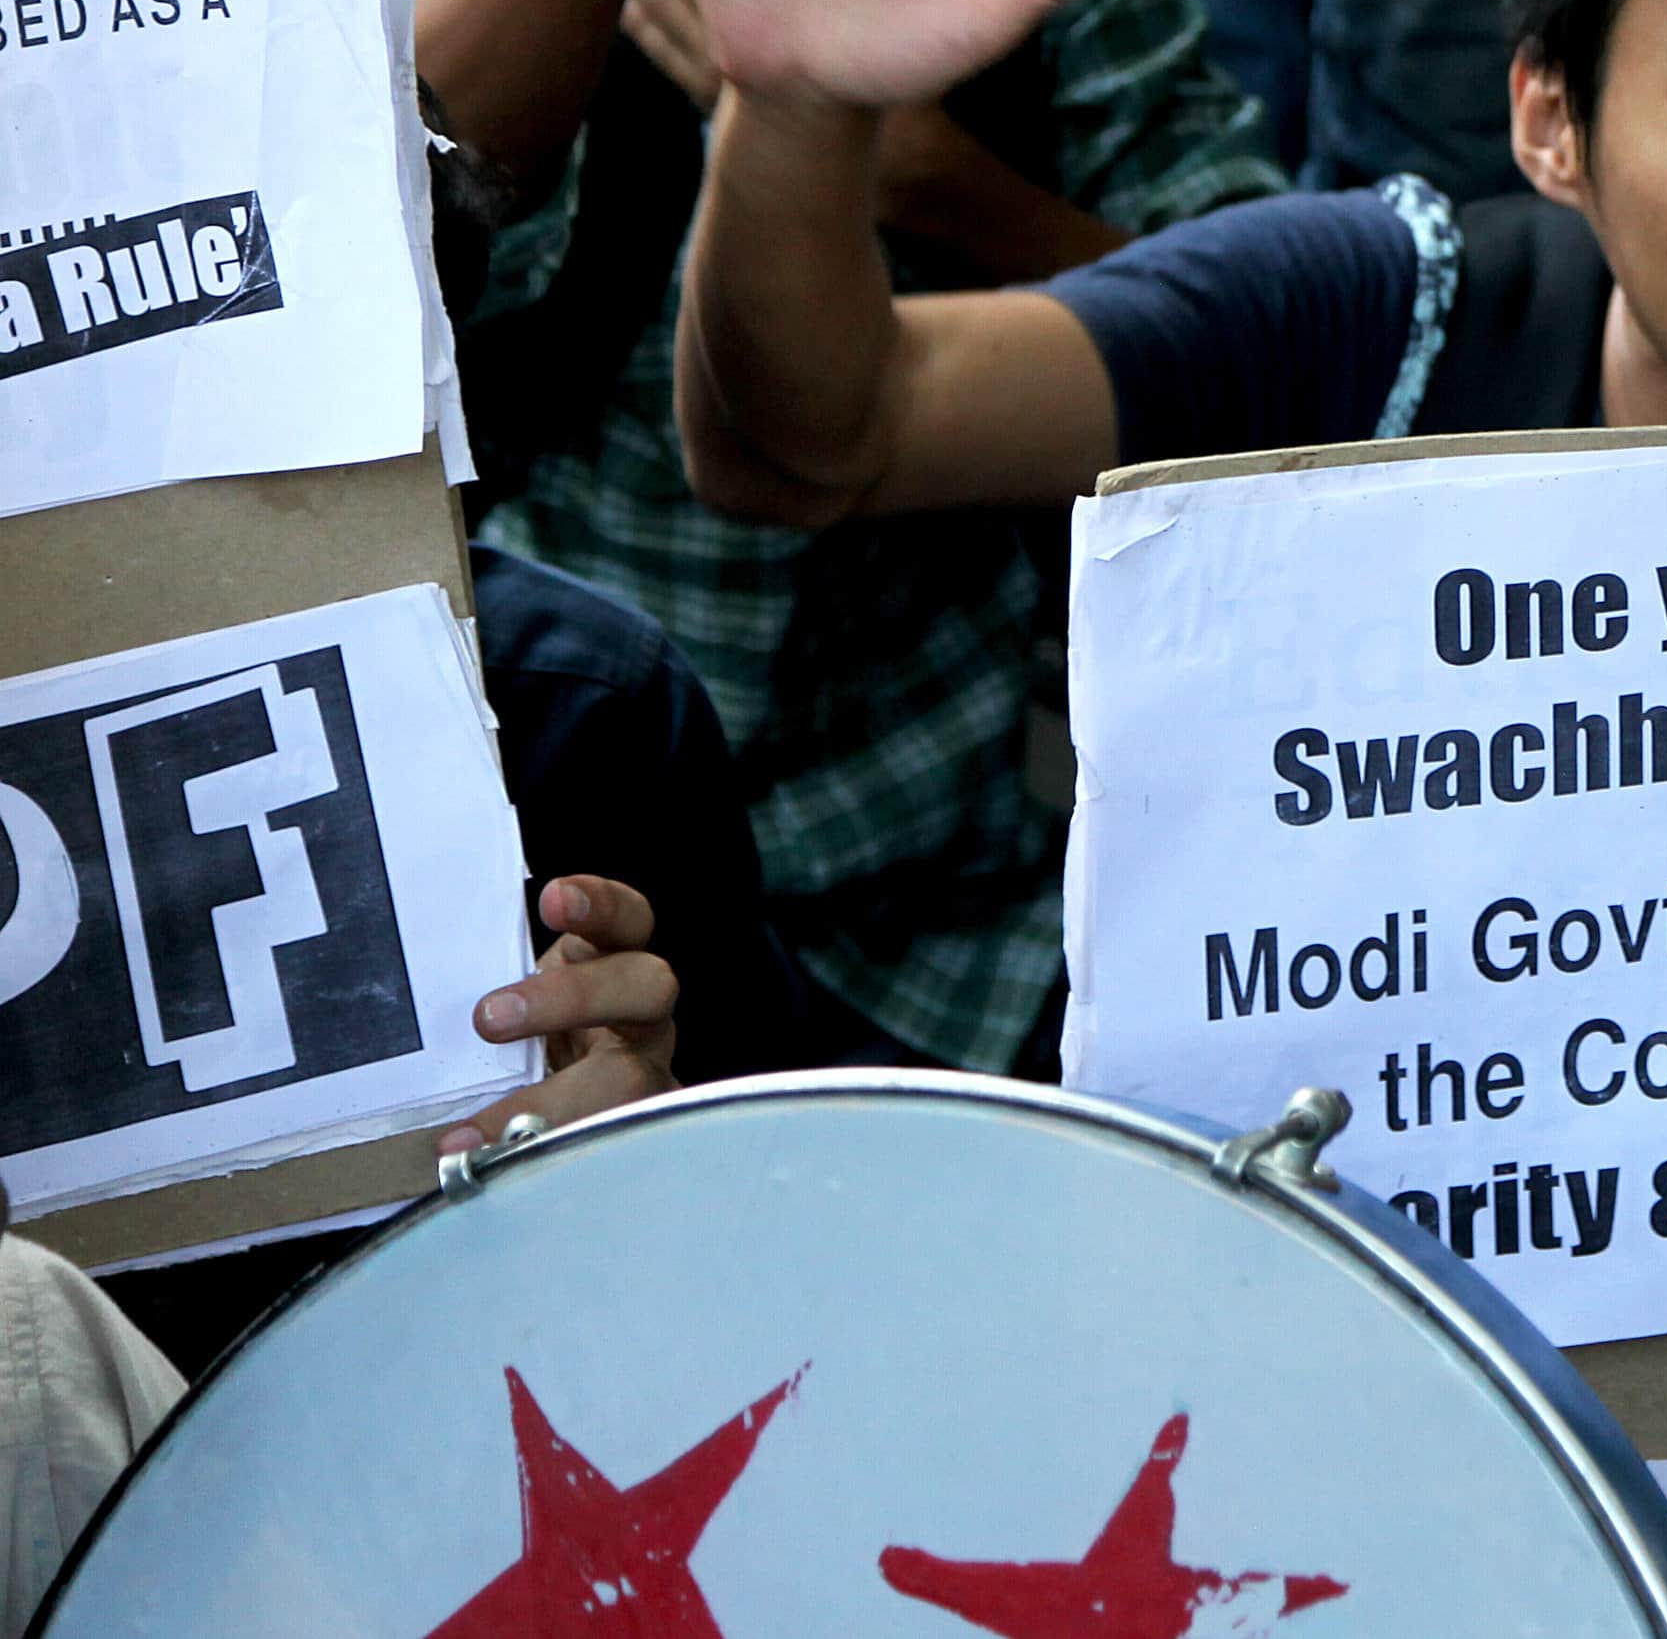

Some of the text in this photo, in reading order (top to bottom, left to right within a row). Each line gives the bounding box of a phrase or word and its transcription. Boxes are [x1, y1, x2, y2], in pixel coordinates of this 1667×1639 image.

[1435, 566, 1629, 666] One
[1205, 909, 1430, 1021] Modi
[1379, 1043, 1525, 1131] the
